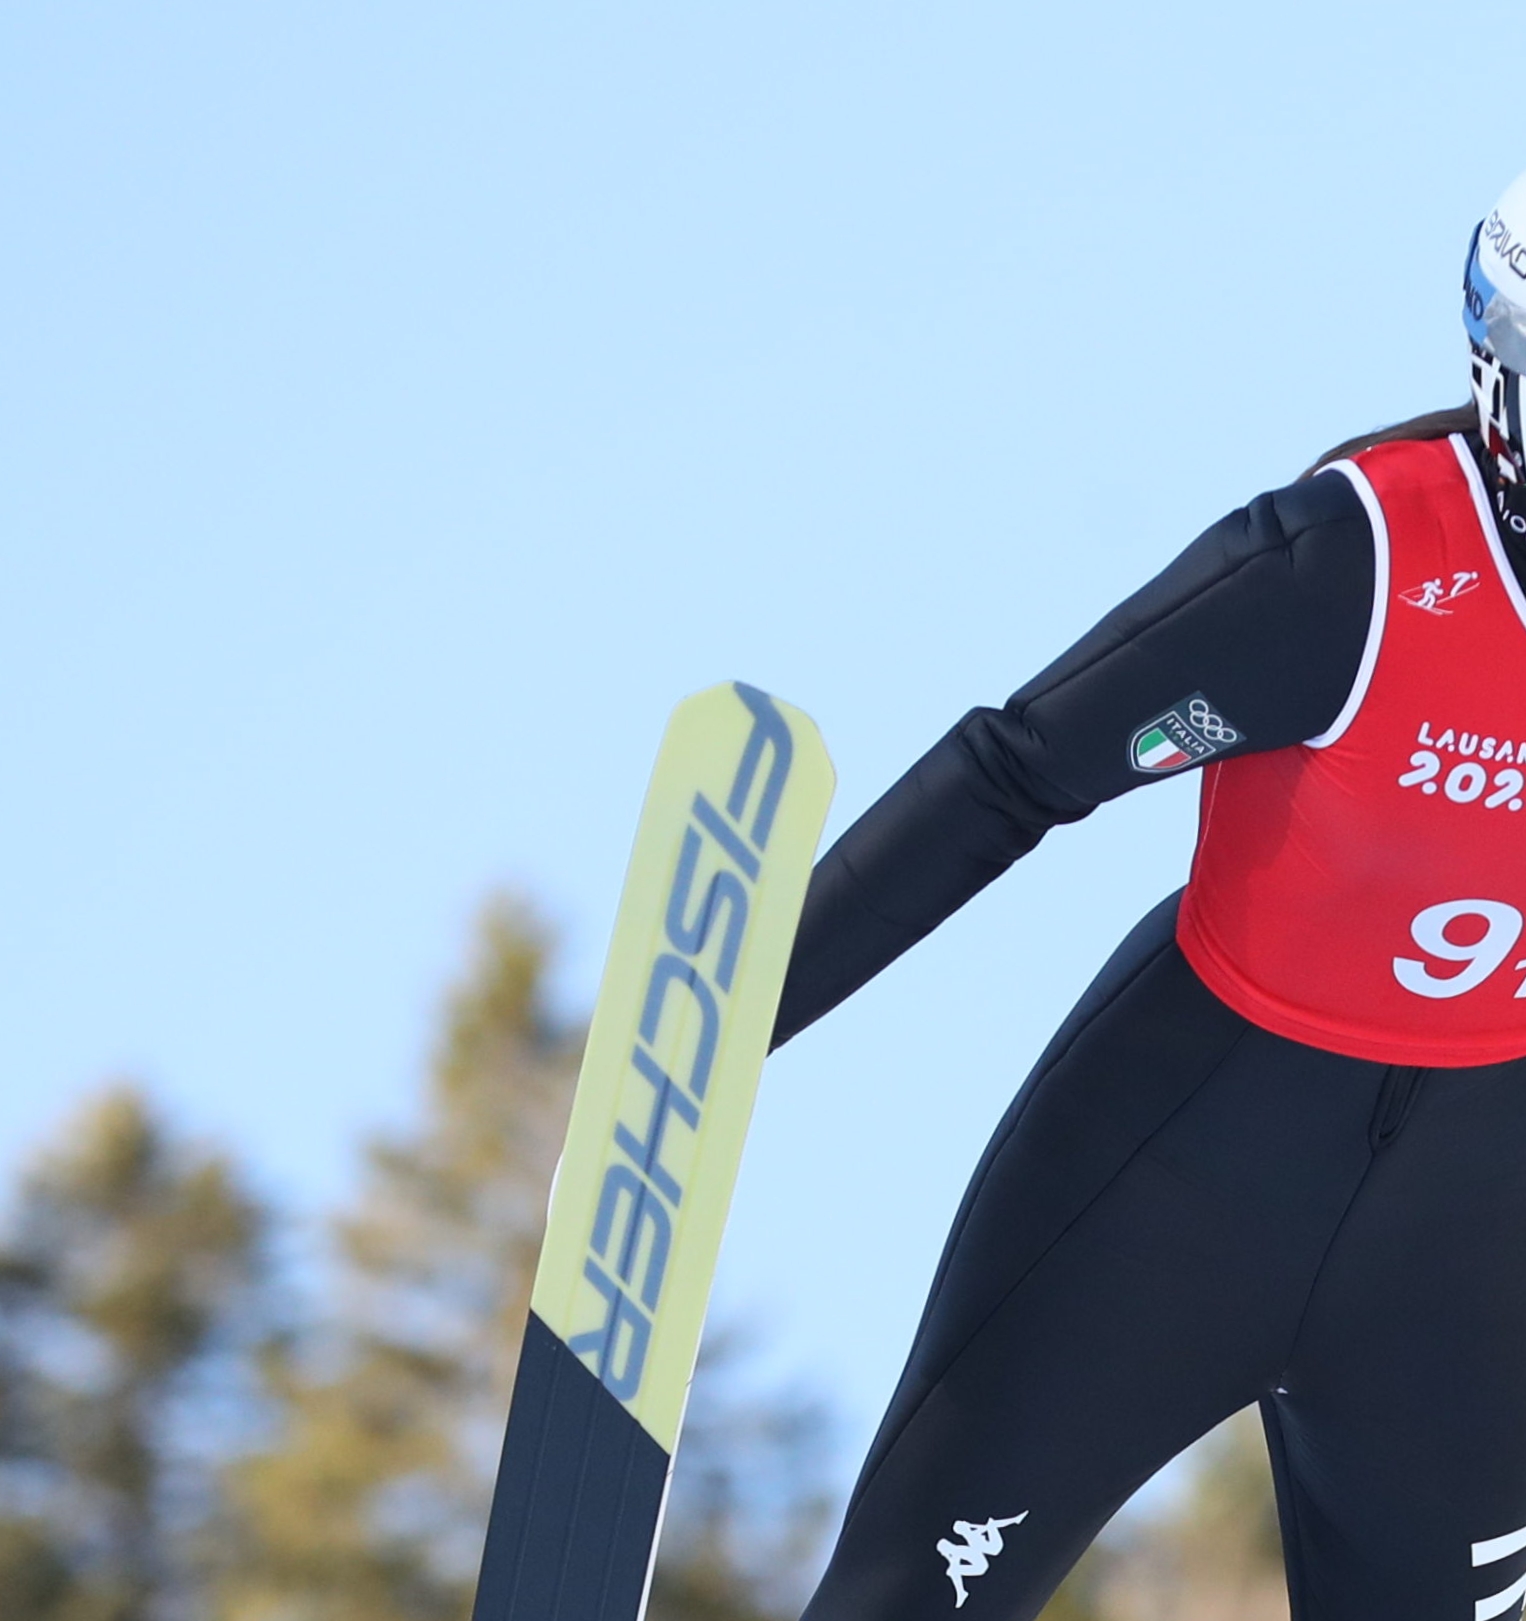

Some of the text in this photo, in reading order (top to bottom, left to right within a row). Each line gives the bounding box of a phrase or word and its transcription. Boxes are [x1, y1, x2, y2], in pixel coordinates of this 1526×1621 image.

[1166, 717, 1205, 754] ITALIA
[1392, 898, 1525, 999] 9
[567, 679, 794, 1402] FISCHER
